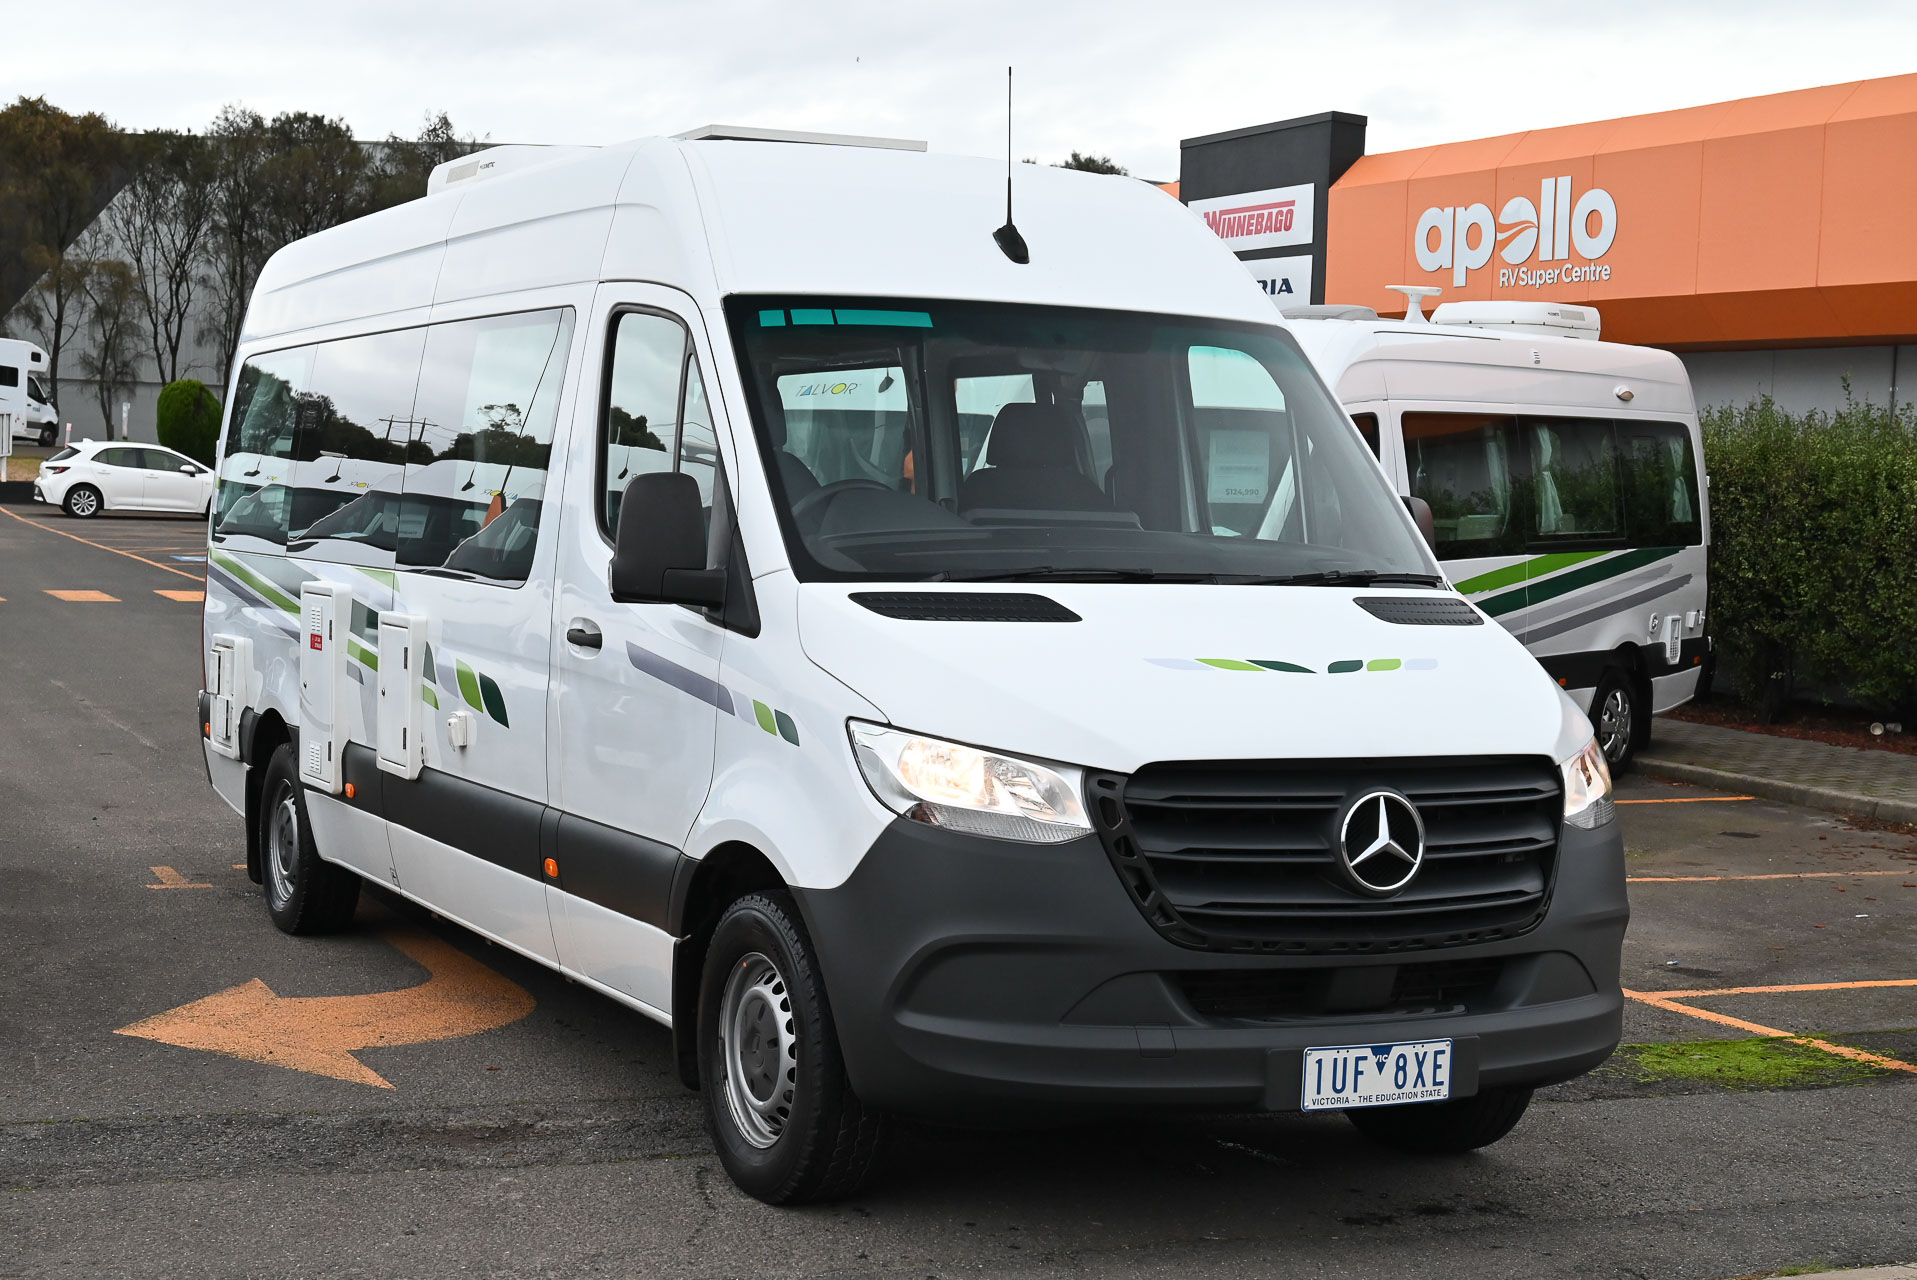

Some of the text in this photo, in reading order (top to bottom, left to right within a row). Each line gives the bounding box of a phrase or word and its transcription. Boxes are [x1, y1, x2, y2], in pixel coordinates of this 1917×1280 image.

[1204, 200, 1295, 239] WINNEBAGO
[1415, 176, 1617, 287] apollo
[1500, 262, 1611, 288] RV Super Centre
[795, 383, 858, 397] TALVOR
[1315, 1050, 1446, 1095] 1UF 8XE
[1311, 1096, 1350, 1106] VICTORIA
[1358, 1094, 1373, 1103] THE
[1375, 1091, 1418, 1102] EDUCATION
[1420, 1088, 1442, 1099] STATE
